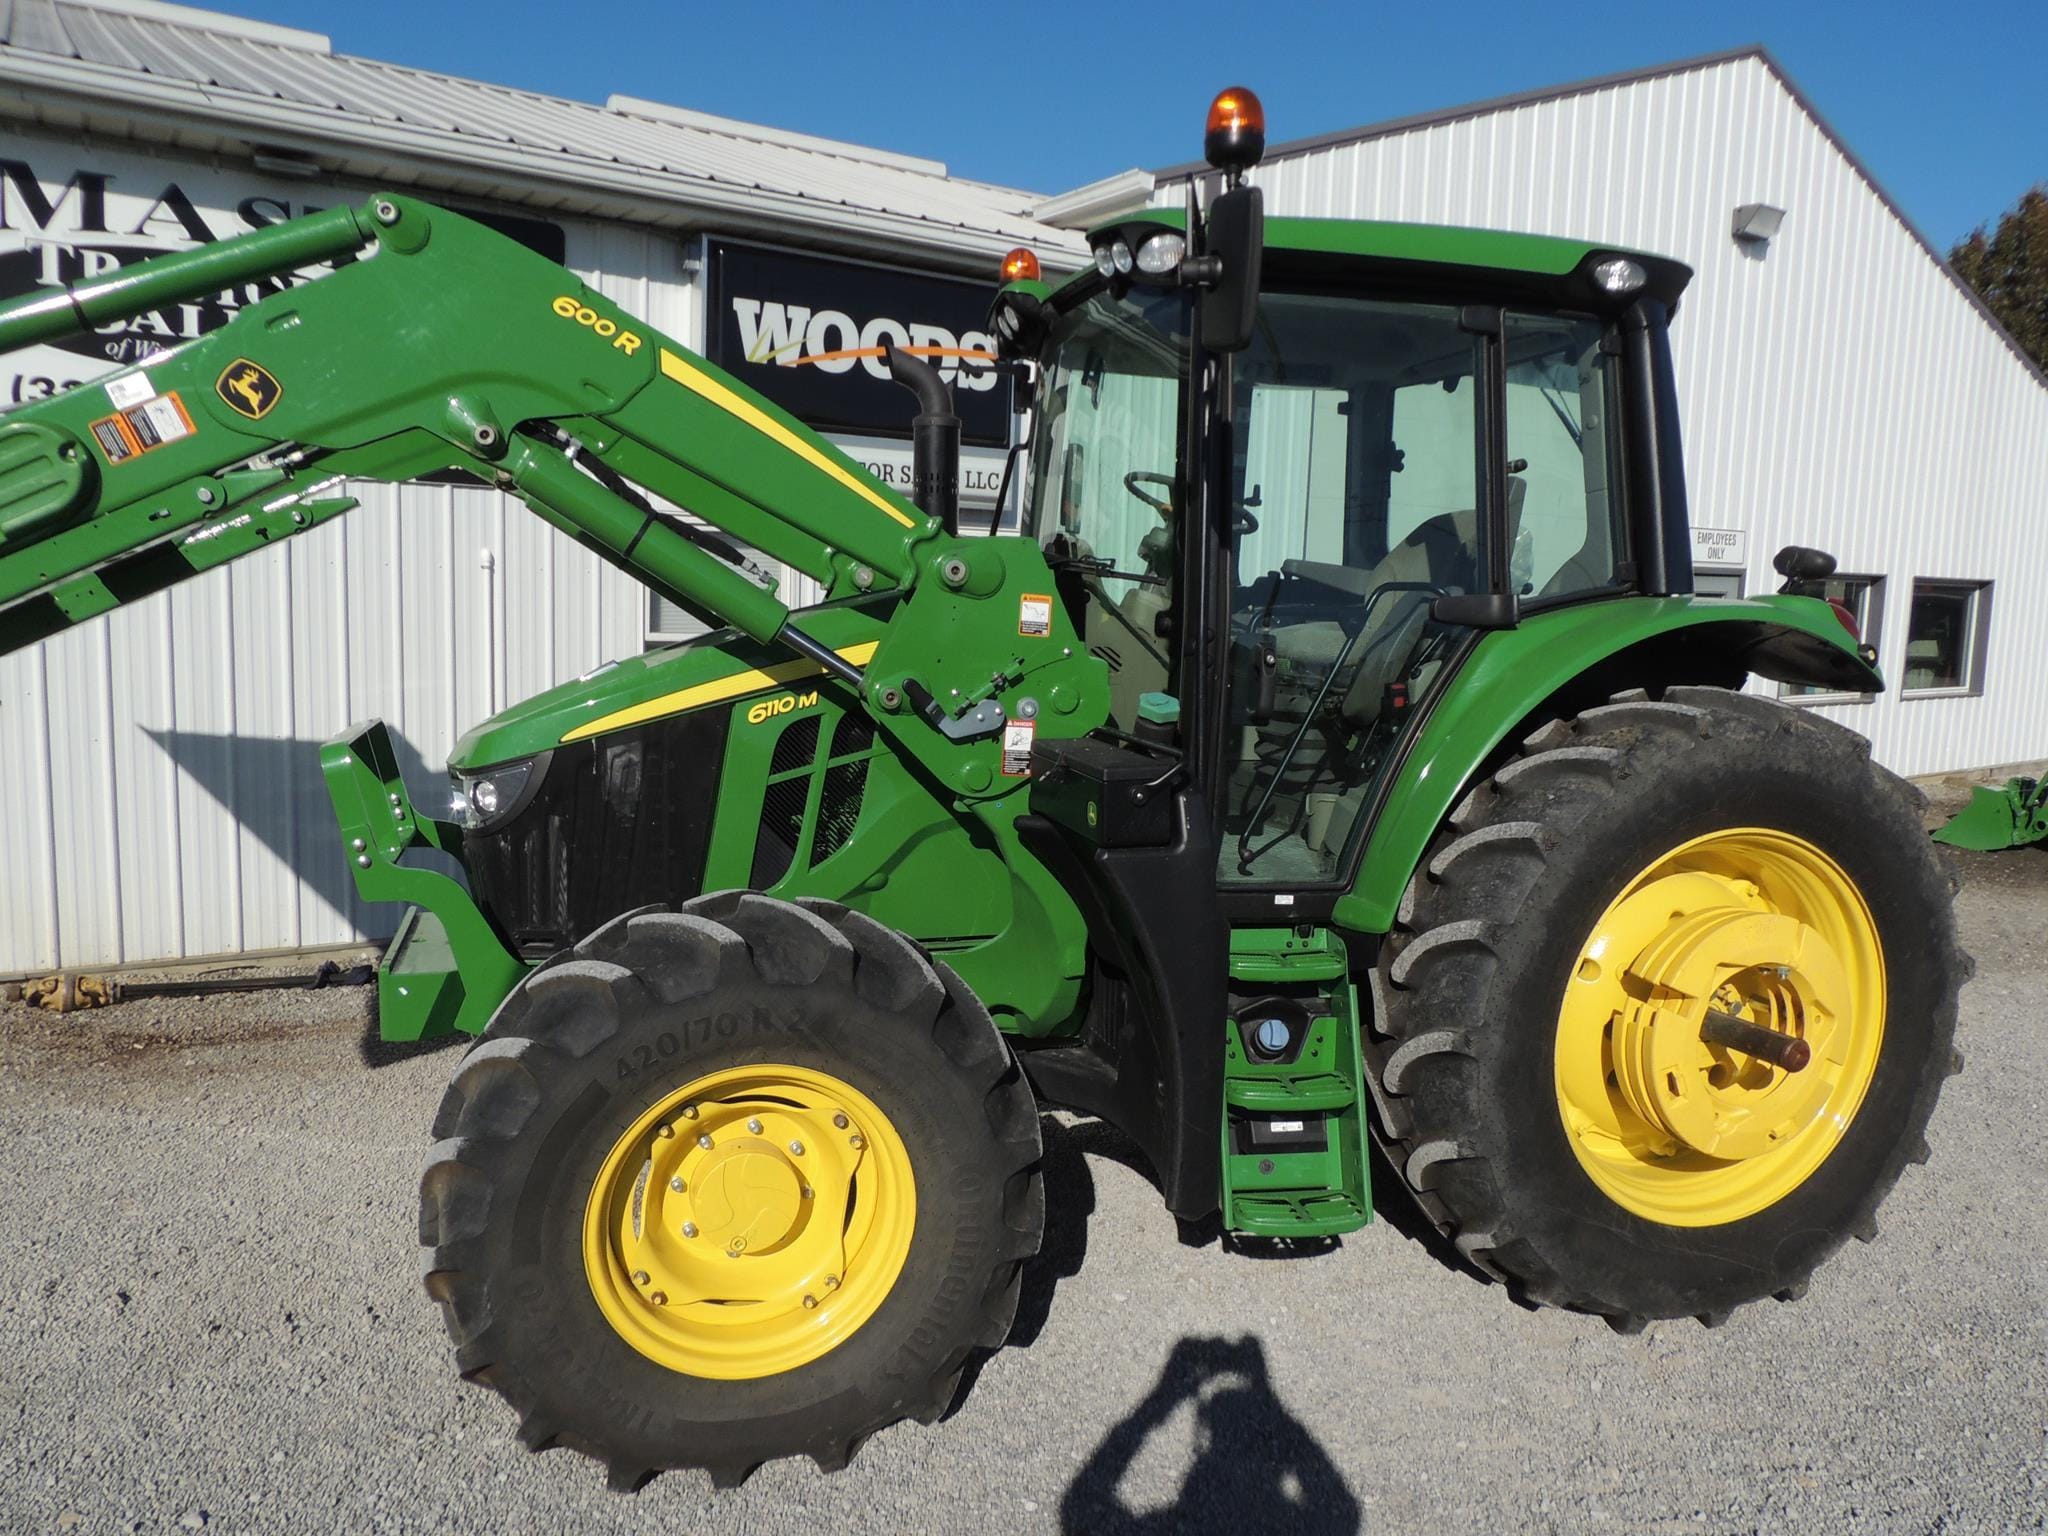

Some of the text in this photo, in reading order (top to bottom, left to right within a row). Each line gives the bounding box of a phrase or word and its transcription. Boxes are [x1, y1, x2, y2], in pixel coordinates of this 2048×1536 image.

[733, 296, 999, 392] WOODS
[965, 470, 1000, 491] LLC
[1697, 531, 1737, 546] EMPLOYEES
[1707, 546, 1726, 560] ONLY
[616, 1012, 741, 1080] 420/70
